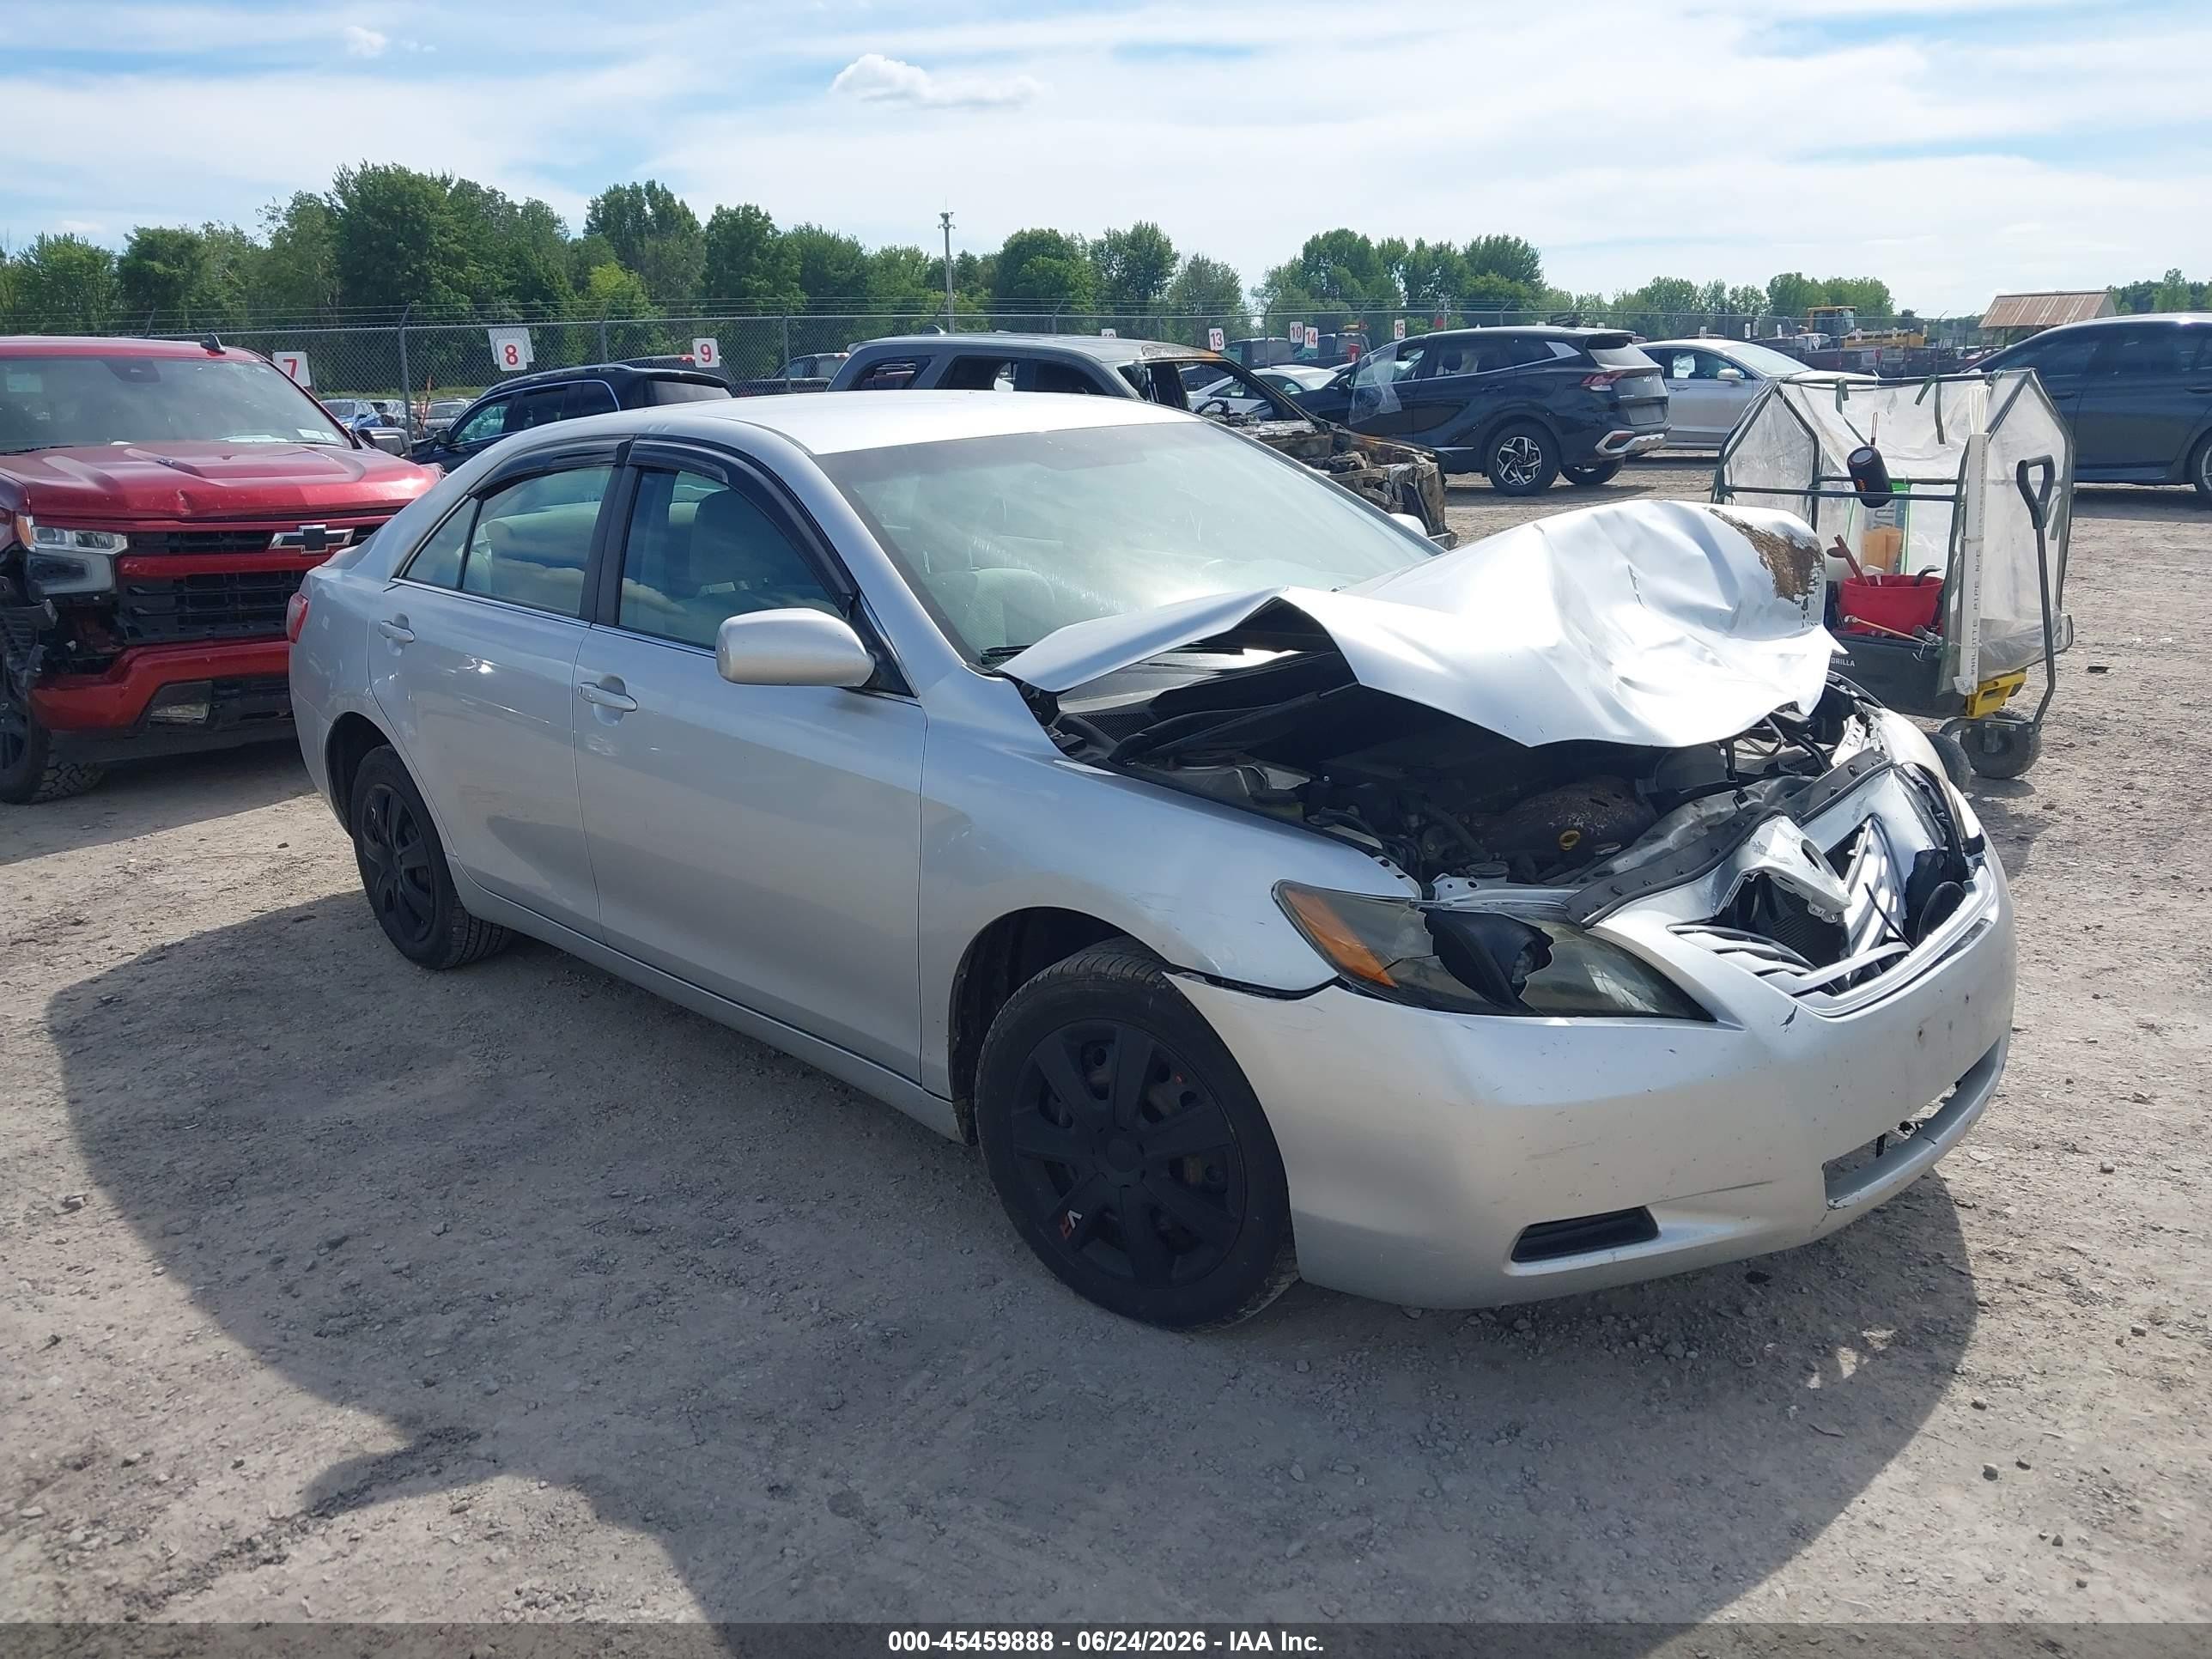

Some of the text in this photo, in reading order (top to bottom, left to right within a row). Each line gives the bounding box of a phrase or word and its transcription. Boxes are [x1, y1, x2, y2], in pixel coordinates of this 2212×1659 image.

[1291, 327, 1302, 339] 10
[1394, 322, 1404, 336] 15
[1211, 332, 1223, 347] 13
[1305, 331, 1316, 345] 14
[505, 344, 519, 365] 8
[701, 343, 713, 362] 9
[283, 359, 298, 378] 7
[1831, 657, 1855, 667] ORILLA
